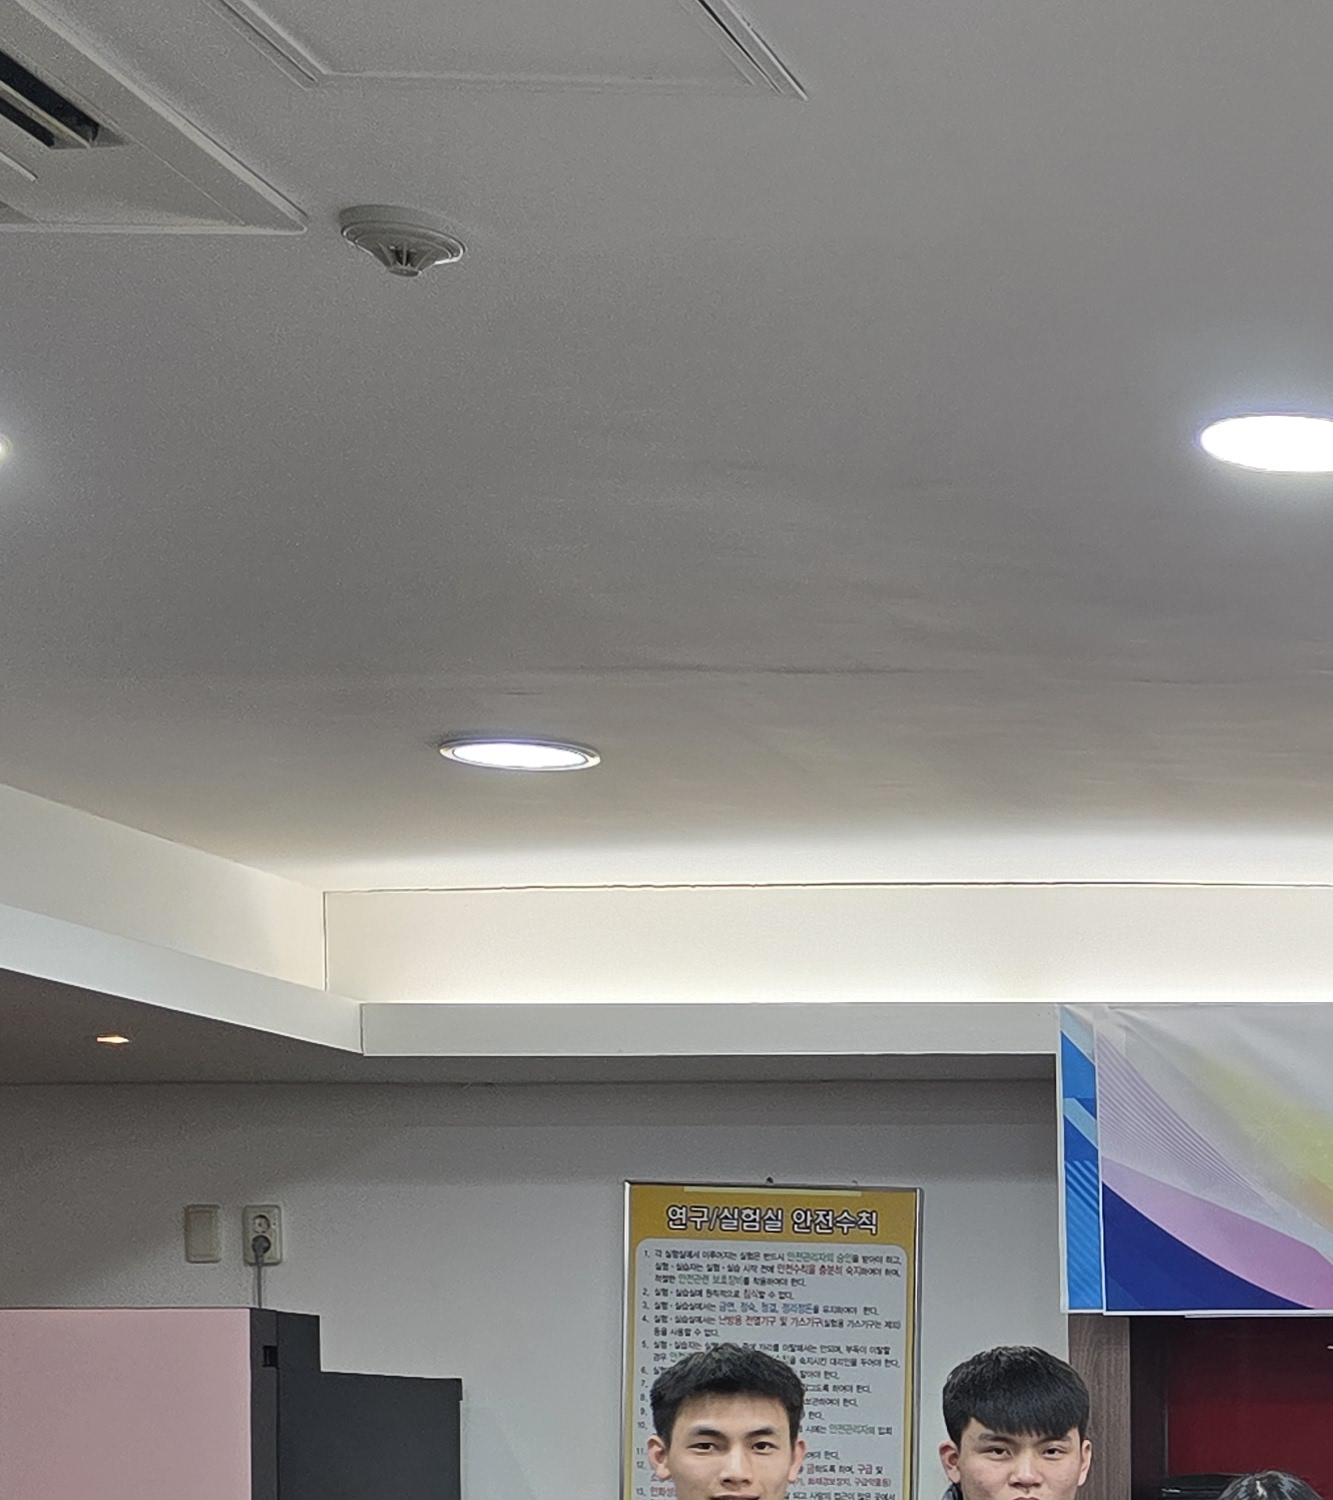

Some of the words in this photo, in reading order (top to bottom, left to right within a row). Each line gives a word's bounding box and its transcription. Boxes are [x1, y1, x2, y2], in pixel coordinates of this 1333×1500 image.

[666, 1205, 785, 1233] 연구/실험실
[792, 1208, 878, 1235] 안전수칙
[650, 1486, 677, 1497] 인화성
